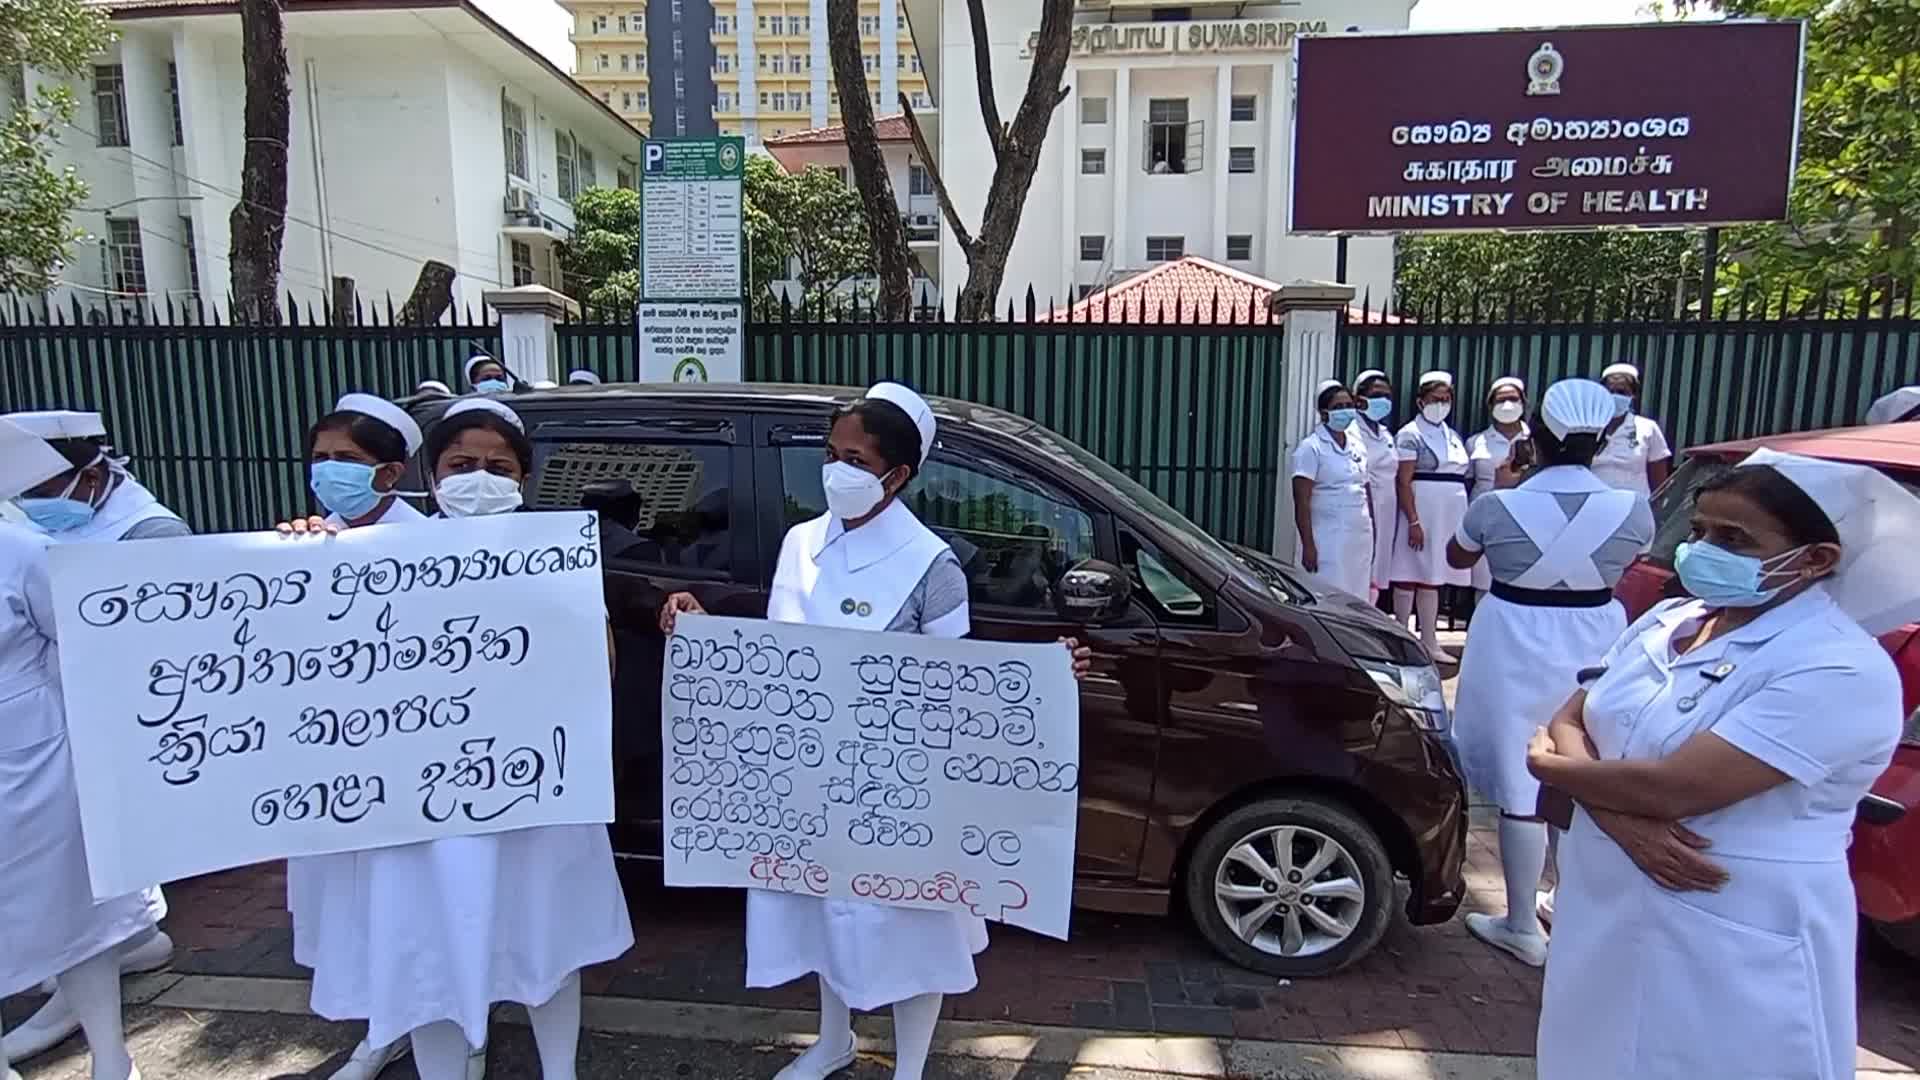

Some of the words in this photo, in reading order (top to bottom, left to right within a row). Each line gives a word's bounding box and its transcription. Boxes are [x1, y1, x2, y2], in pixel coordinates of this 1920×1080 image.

[1392, 121, 1491, 145] සෞඛ්‍ය
[1506, 117, 1690, 146] අමාත්‍යාංශය
[646, 144, 663, 171] P
[1403, 159, 1517, 184] சுகாதார
[1531, 146, 1673, 179] அமைச்சு
[1368, 193, 1513, 218] MINISTRY
[1527, 191, 1568, 215] OF
[1582, 188, 1709, 213] HEALTH
[79, 569, 312, 627] සෞඛ්‍ය
[288, 688, 477, 748] කලාපය
[670, 674, 835, 723] අධ්‍යාපන
[670, 756, 795, 802] තනතුර
[836, 740, 929, 785] අදාල
[944, 753, 1079, 793] නොවන
[251, 773, 386, 826] හෙළා
[960, 824, 1022, 867] වල
[750, 855, 829, 894] අදාල
